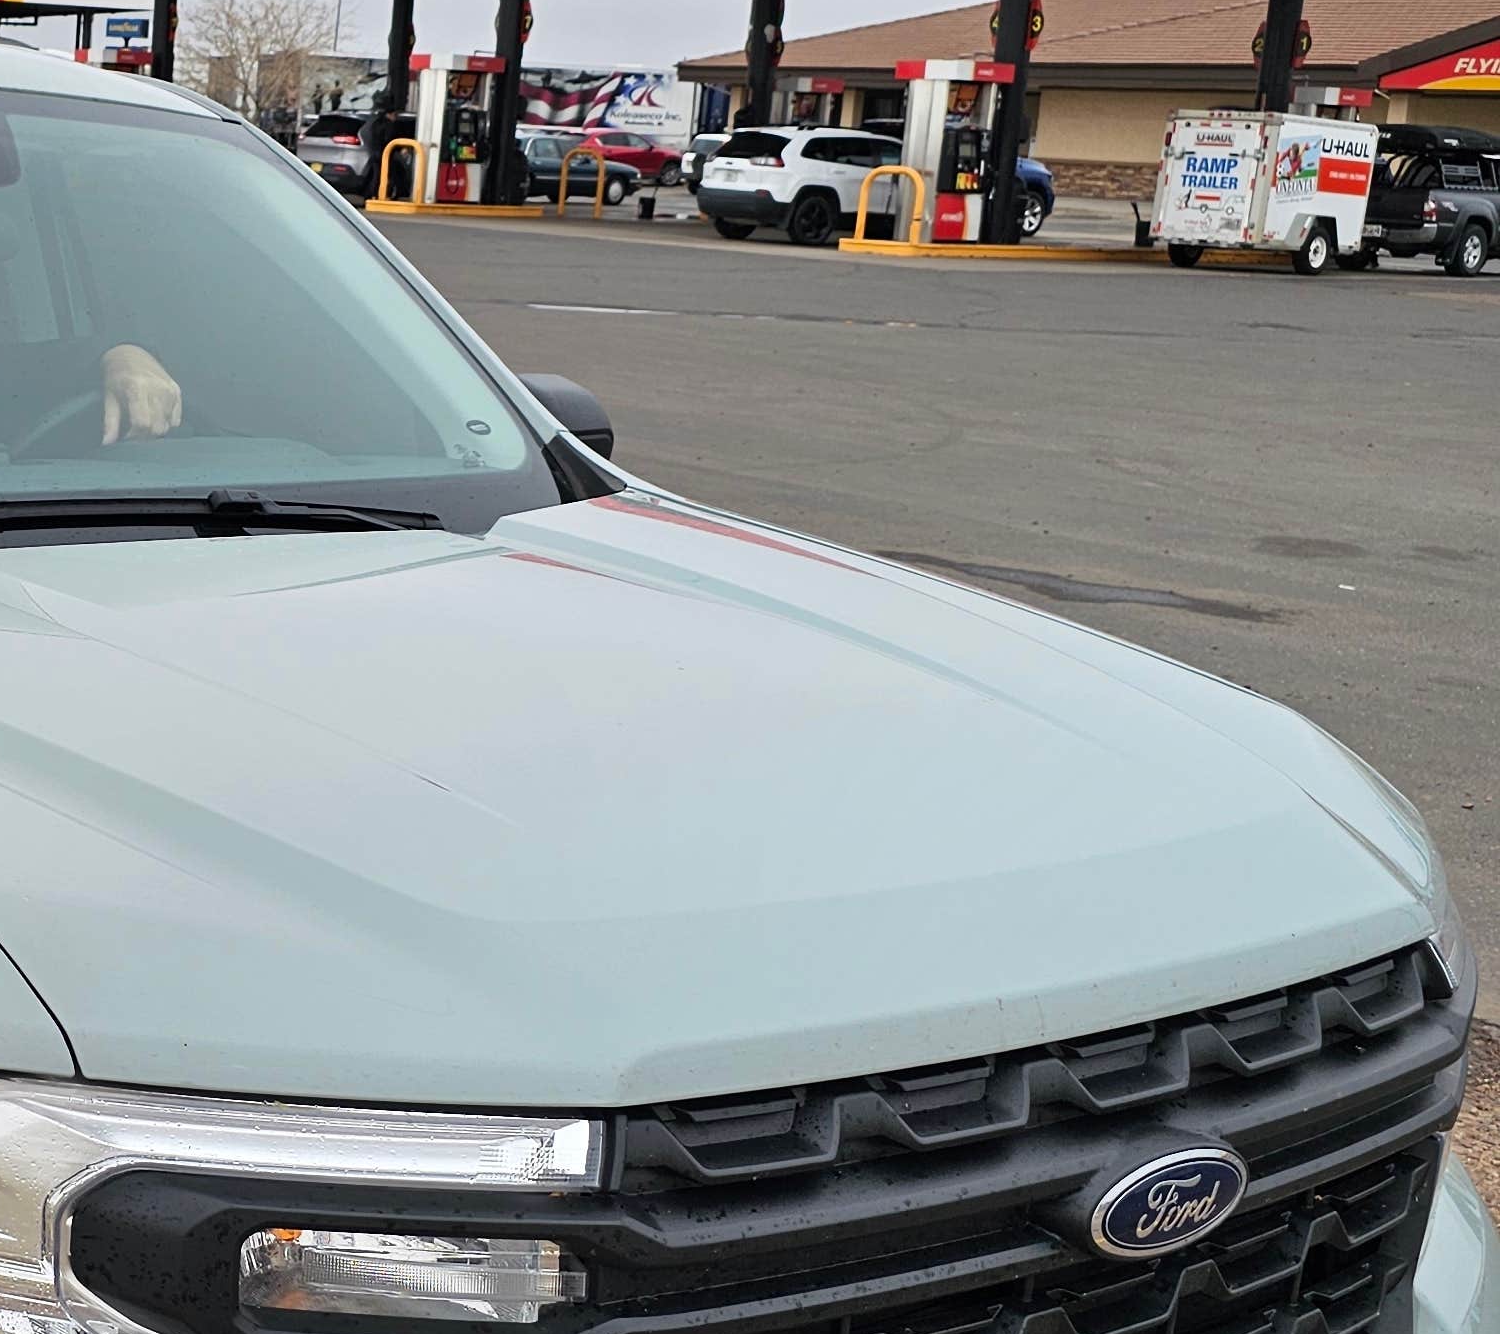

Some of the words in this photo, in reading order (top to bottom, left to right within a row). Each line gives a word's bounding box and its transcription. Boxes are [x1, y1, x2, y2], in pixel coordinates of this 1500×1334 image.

[1032, 16, 1041, 32] 3
[1301, 37, 1308, 51] 1
[1186, 157, 1238, 174] RAMP
[1181, 175, 1238, 190] TRAILER
[1136, 1173, 1221, 1239] Ford
